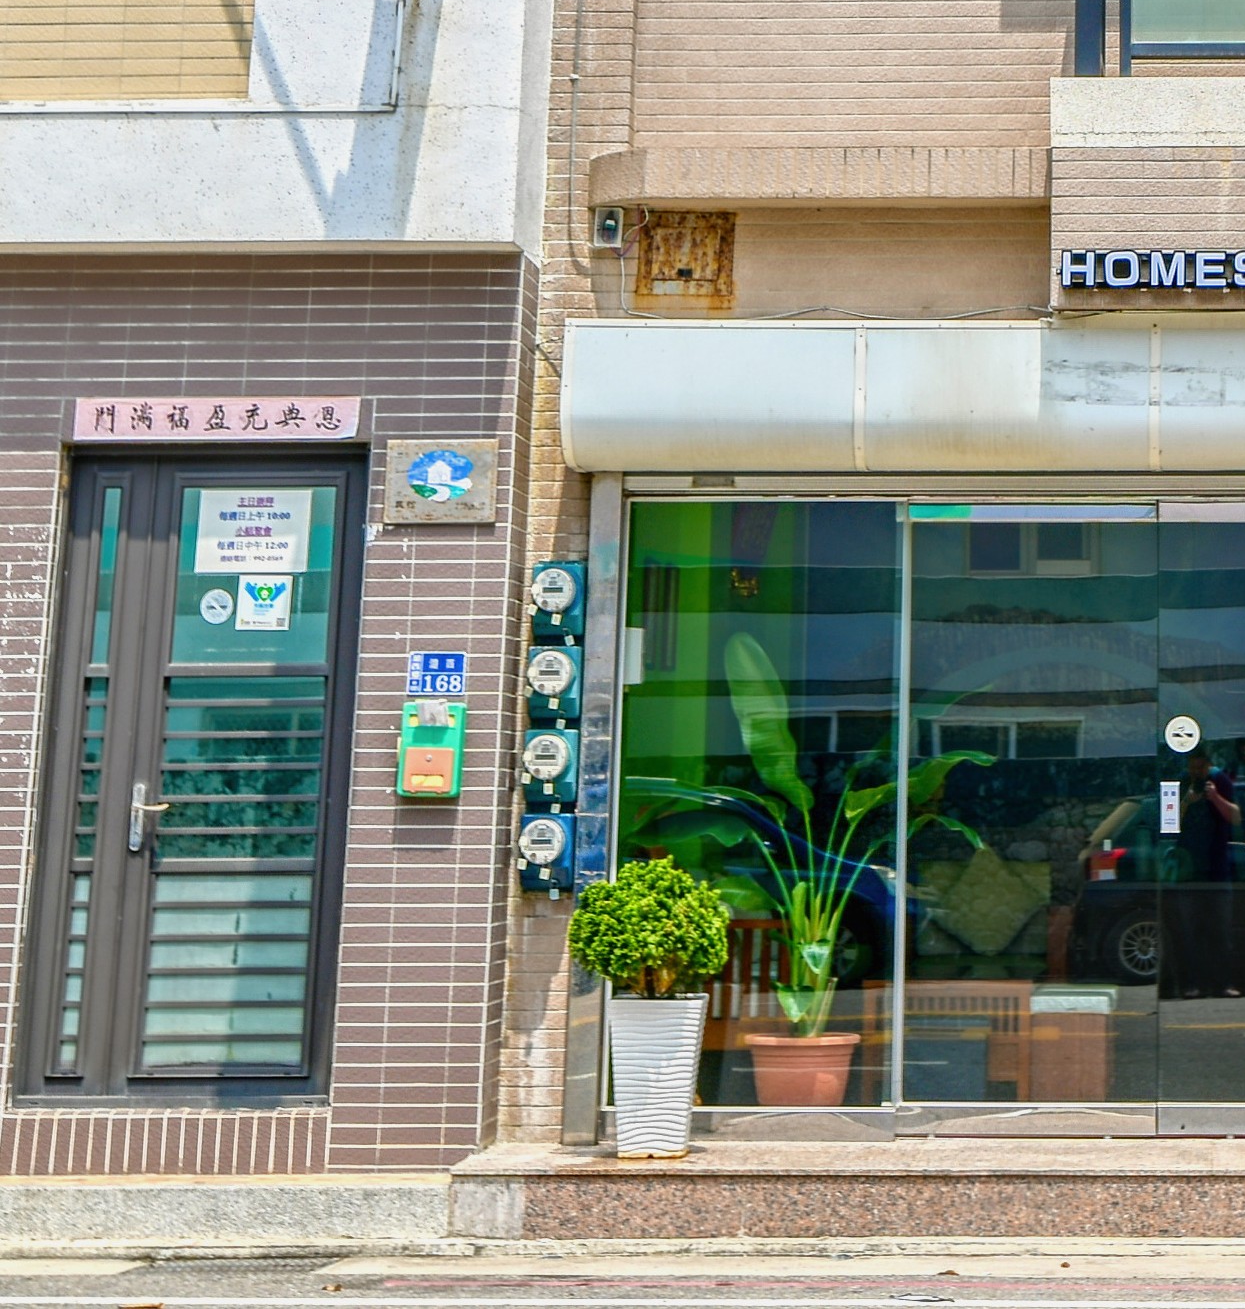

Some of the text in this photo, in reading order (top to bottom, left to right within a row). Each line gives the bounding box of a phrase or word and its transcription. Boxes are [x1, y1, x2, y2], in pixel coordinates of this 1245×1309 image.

[267, 512, 291, 520] 10:00
[265, 542, 289, 550] 12:00
[423, 674, 462, 692] 168
